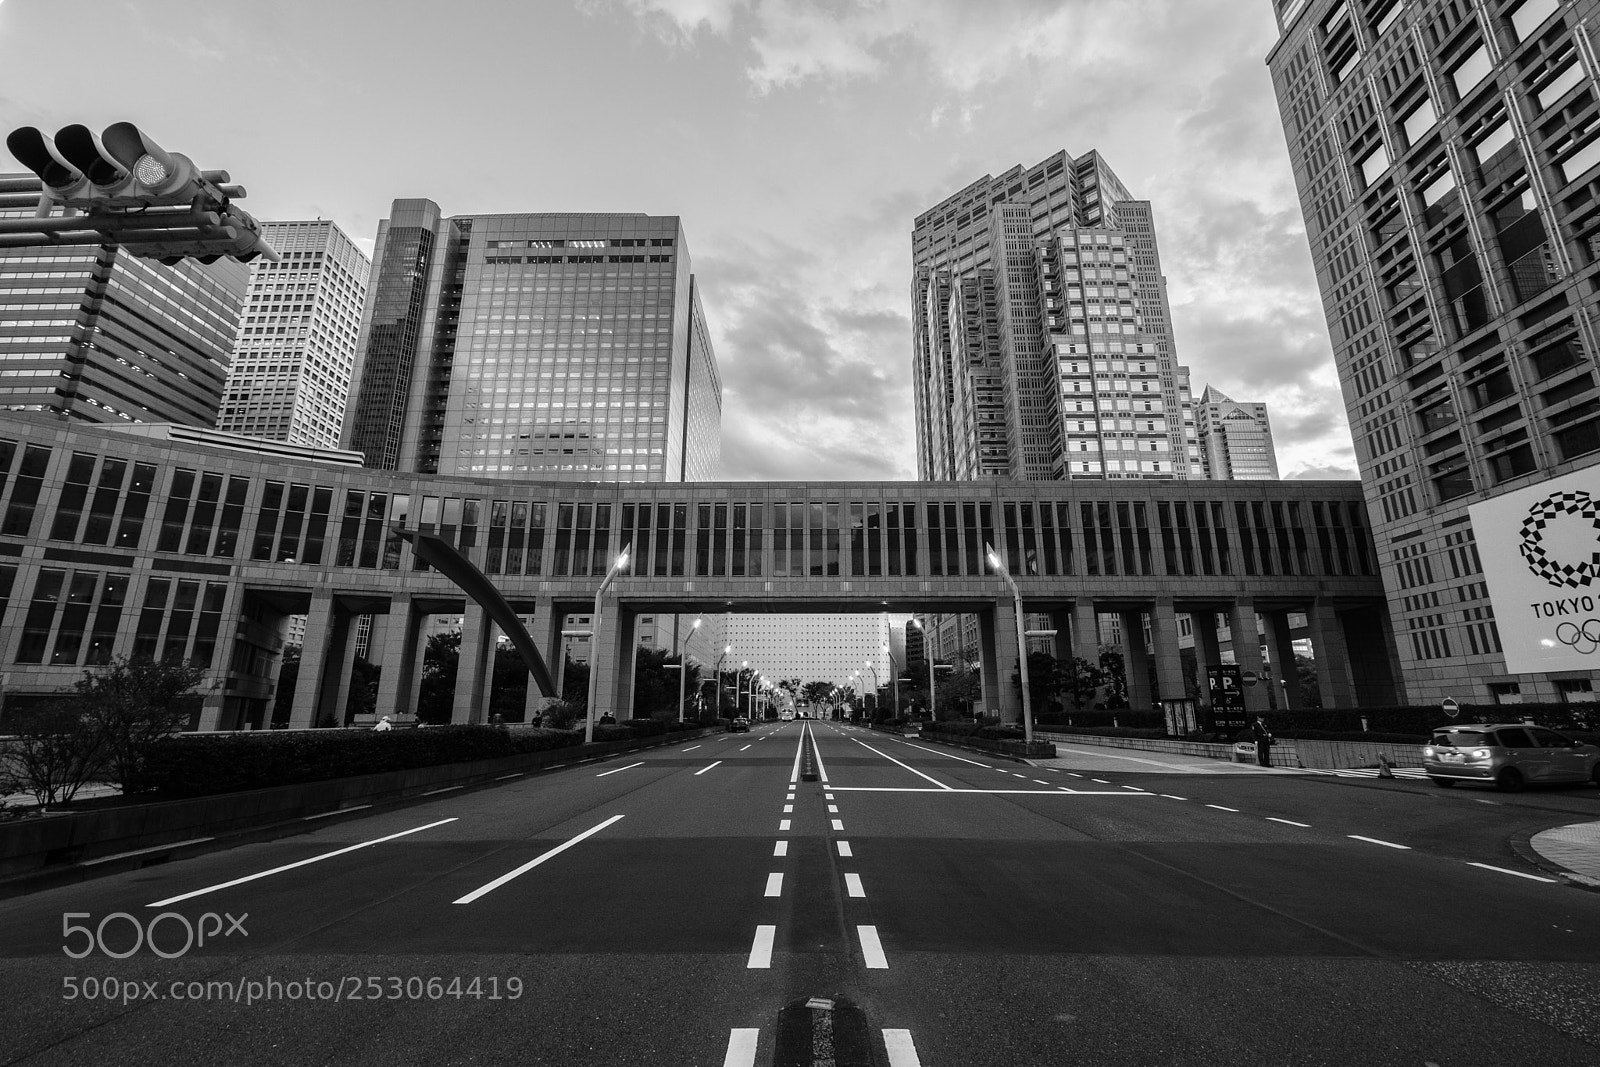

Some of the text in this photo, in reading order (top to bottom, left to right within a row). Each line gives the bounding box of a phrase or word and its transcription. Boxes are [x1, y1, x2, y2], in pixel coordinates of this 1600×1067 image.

[1531, 596, 1594, 618] TOKYO
[1209, 677, 1216, 690] P
[1222, 676, 1233, 690] P
